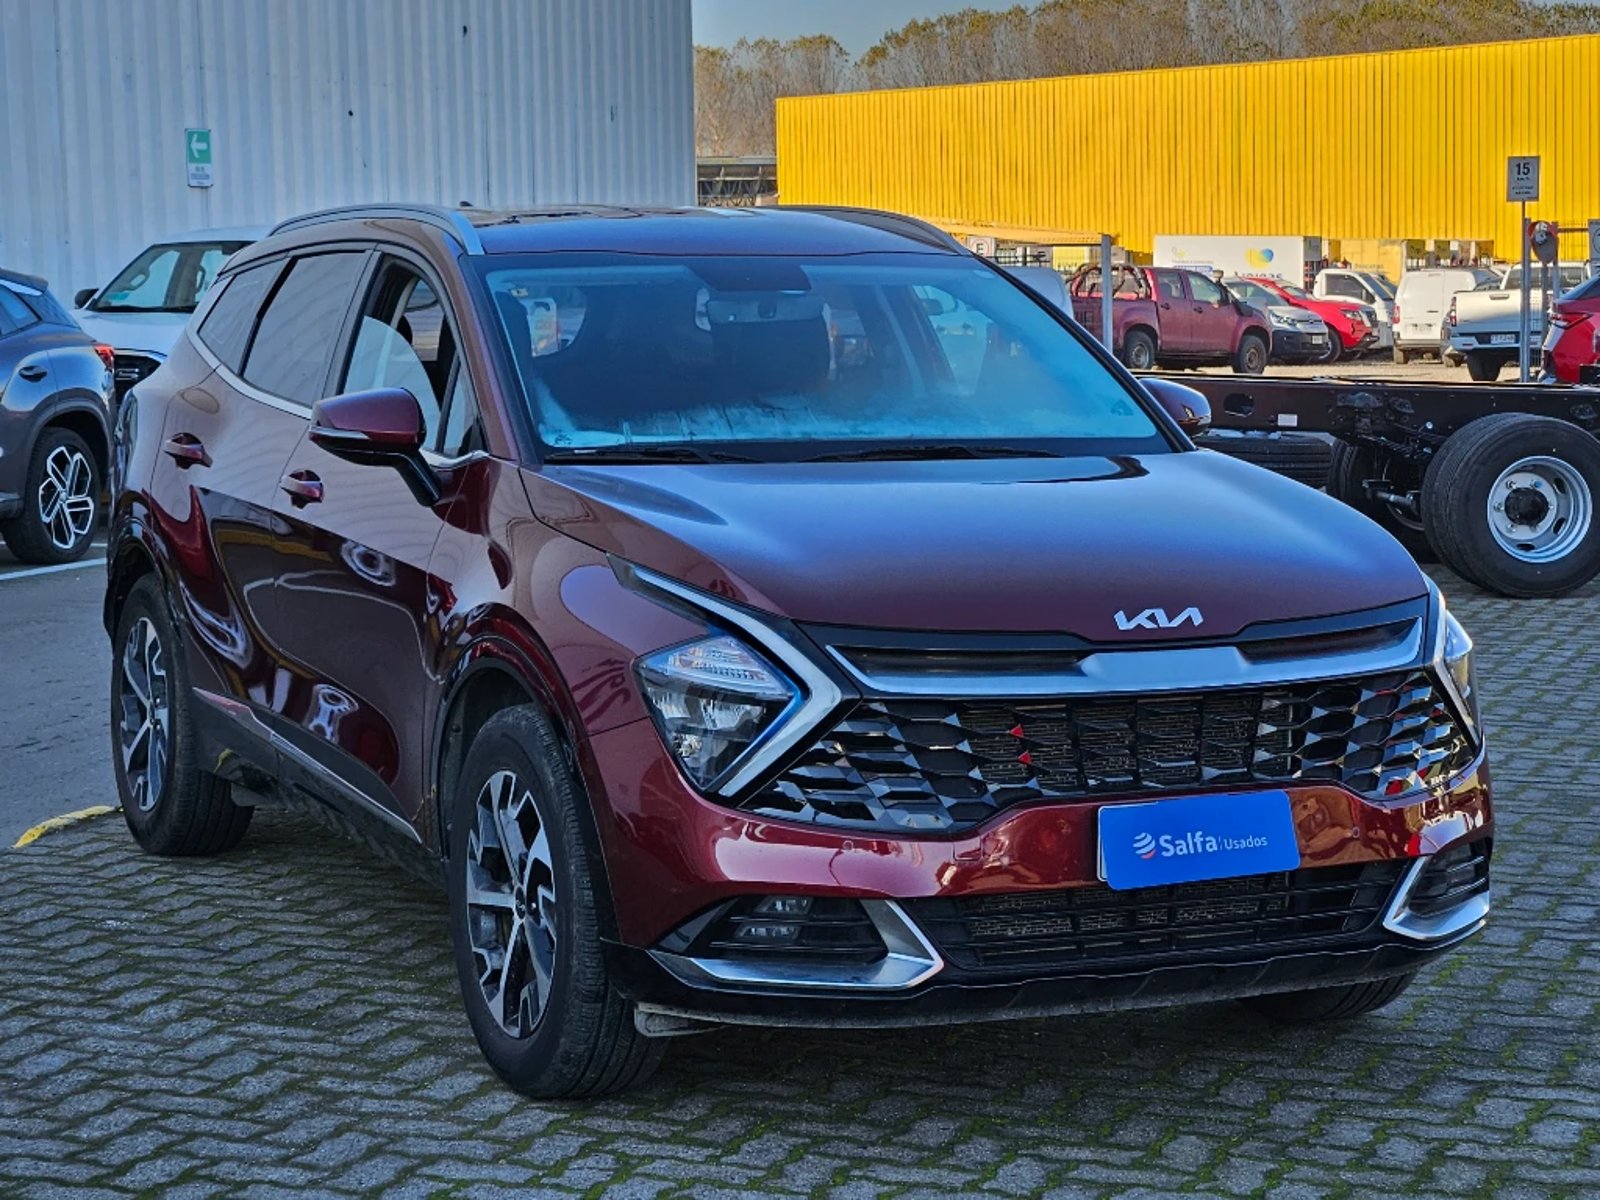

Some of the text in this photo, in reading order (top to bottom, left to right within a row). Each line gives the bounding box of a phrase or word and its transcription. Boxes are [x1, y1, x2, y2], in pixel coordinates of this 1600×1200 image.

[1515, 162, 1531, 176] 15
[1113, 606, 1204, 631] KIA
[1158, 830, 1269, 858] Salfa Usados
